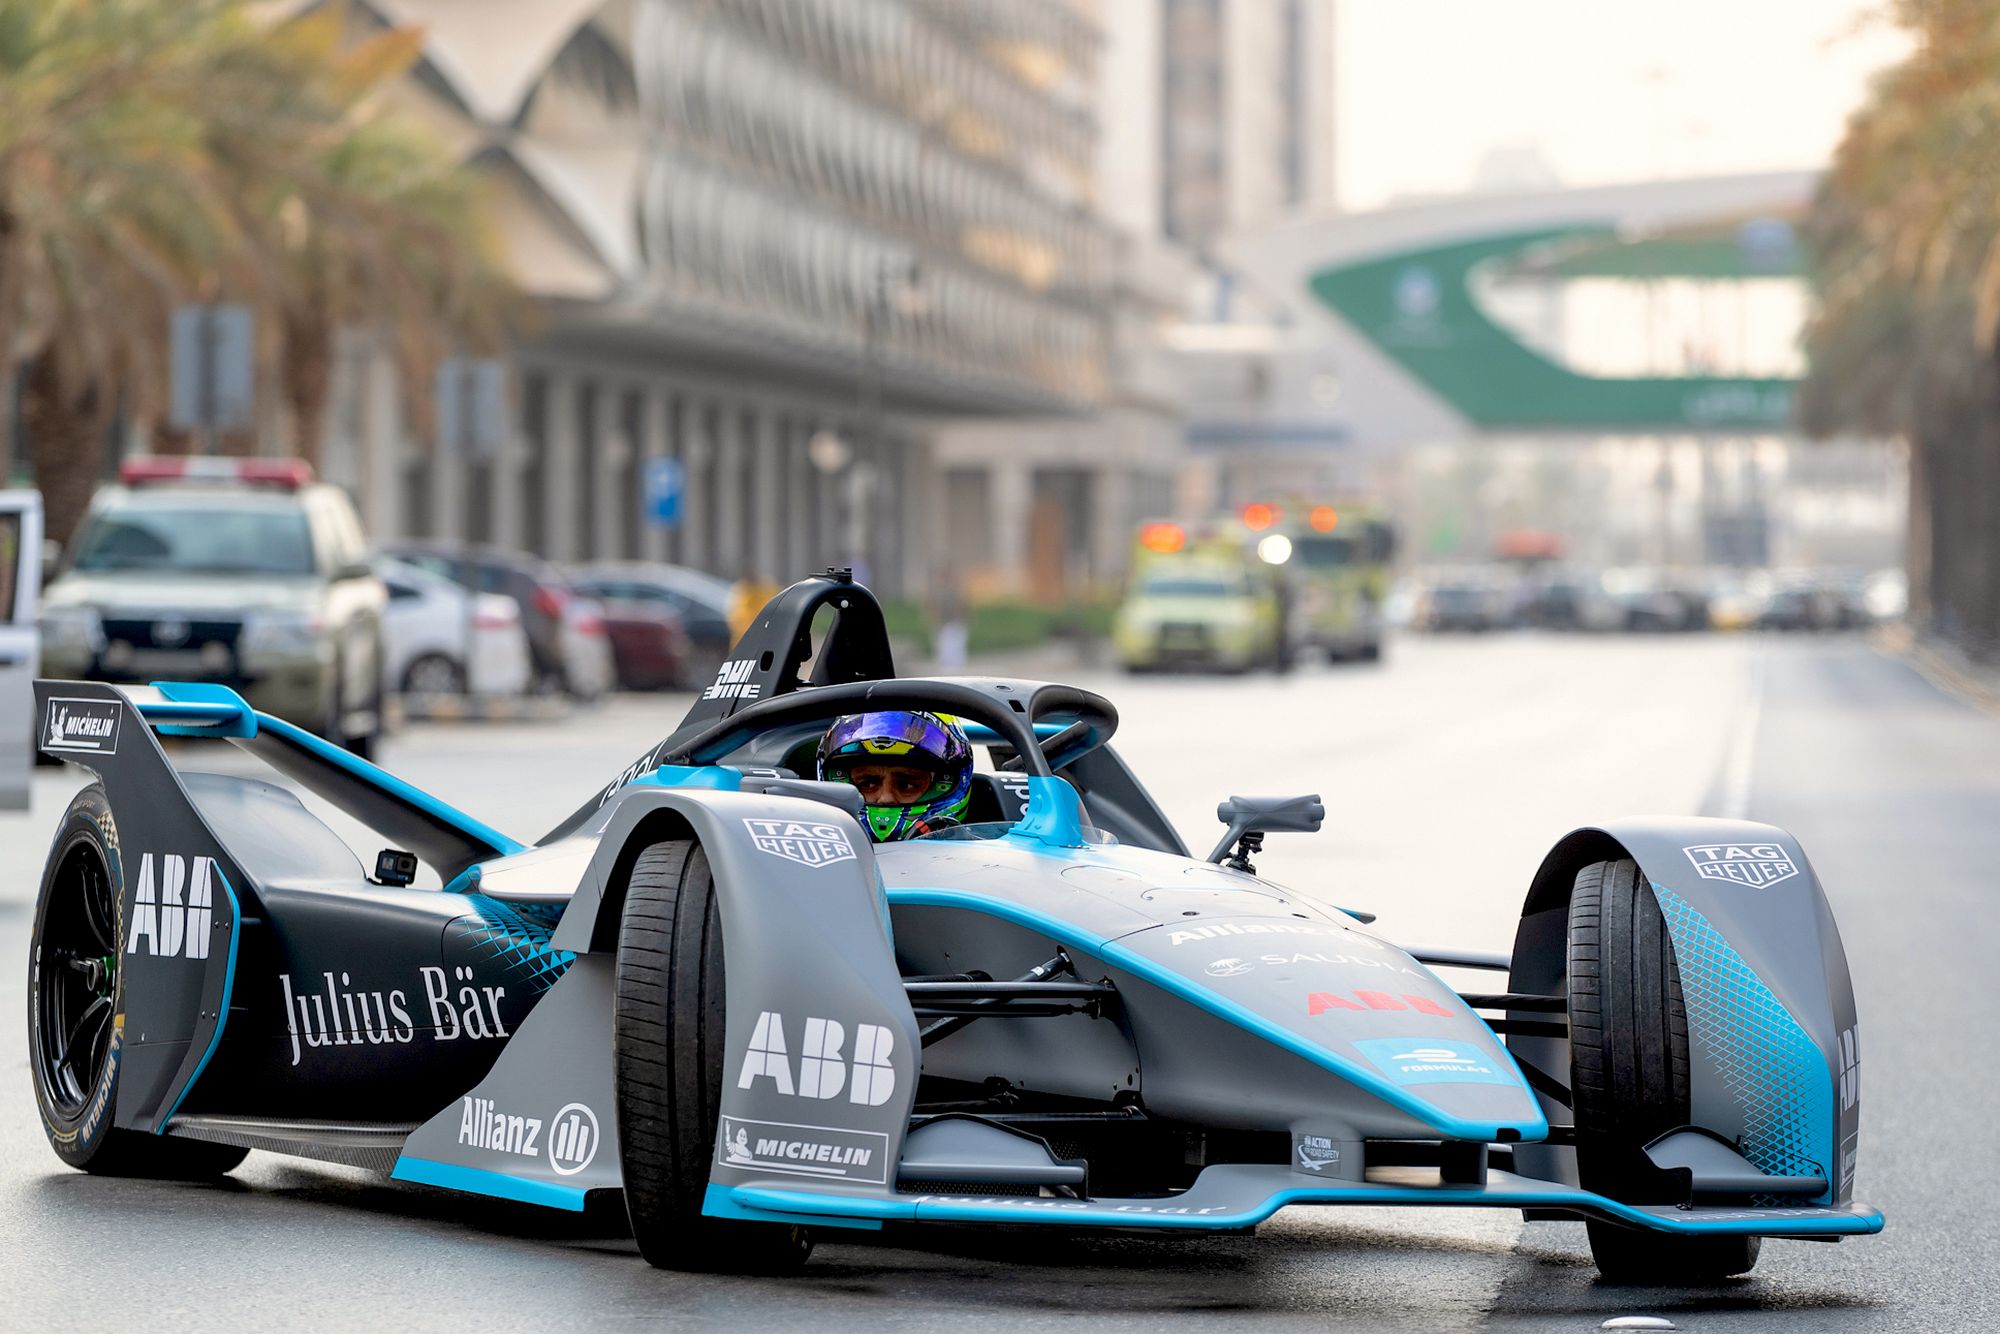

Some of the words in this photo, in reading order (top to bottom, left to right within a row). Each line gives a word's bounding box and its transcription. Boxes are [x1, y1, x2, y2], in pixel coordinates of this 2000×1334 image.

[65, 716, 114, 737] MICHELIN
[753, 822, 840, 840] TAG
[760, 839, 850, 863] HEUER
[1694, 846, 1779, 860] TAG
[1703, 863, 1791, 884] HEUER
[1167, 923, 1315, 946] Allianz
[279, 971, 414, 1066] Julius
[419, 966, 510, 1040] Bär
[1307, 990, 1454, 1018] ABB
[737, 1011, 895, 1106] ABB
[82, 1054, 117, 1144] MICHELIN
[458, 1096, 543, 1156] Allianz
[755, 1139, 872, 1166] MICHELIN
